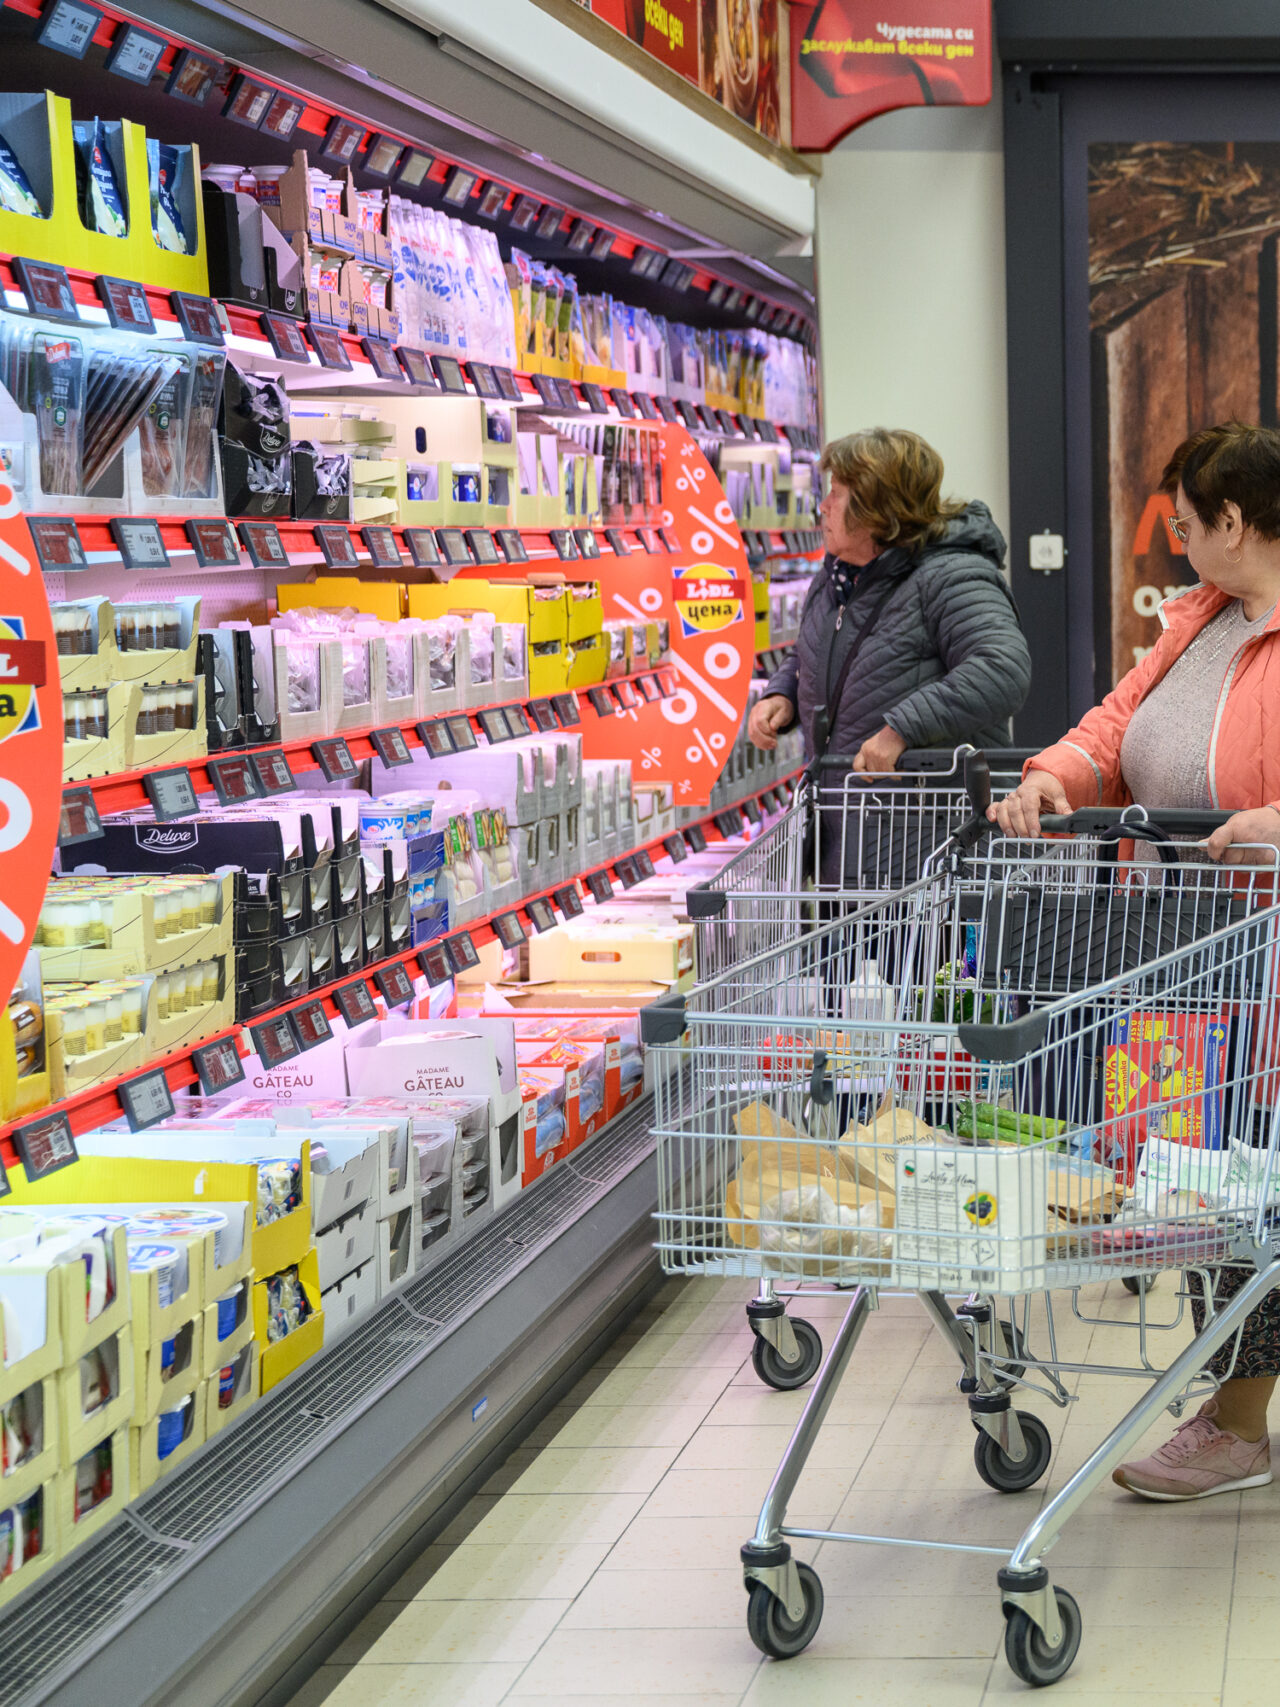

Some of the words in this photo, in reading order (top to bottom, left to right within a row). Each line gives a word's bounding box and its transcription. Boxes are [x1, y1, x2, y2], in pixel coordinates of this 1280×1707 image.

[669, 13, 684, 51] ден
[876, 22, 952, 42] Чудесата
[956, 28, 974, 40] си
[801, 38, 895, 57] заслужават
[898, 38, 943, 56] всеки
[946, 43, 974, 59] ден
[688, 604, 733, 622] цена
[142, 827, 192, 845] Deluxe
[265, 1064, 300, 1072] ADAME
[416, 1066, 450, 1075] MADAME
[252, 1073, 313, 1089] GÂTEAU
[404, 1075, 465, 1091] GÂTEAU
[1105, 1061, 1121, 1104] 50%
